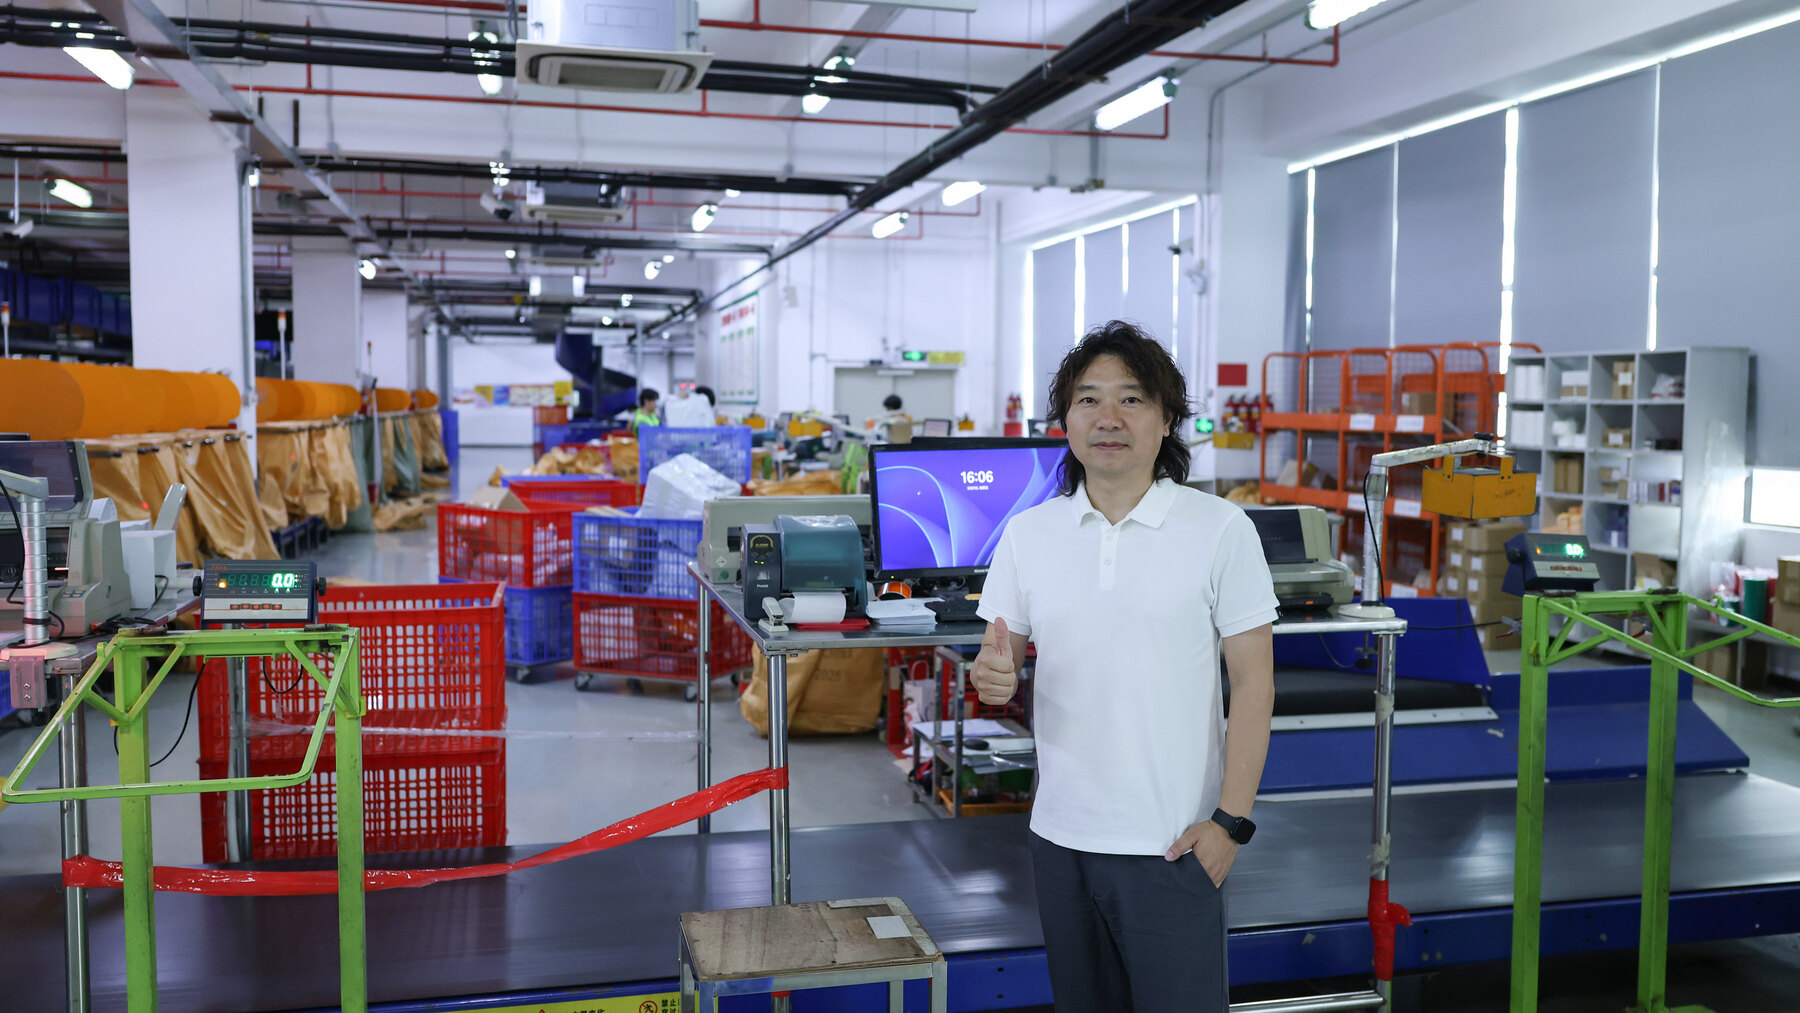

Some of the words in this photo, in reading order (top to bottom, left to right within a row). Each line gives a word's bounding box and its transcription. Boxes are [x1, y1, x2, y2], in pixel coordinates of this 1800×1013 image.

[960, 471, 994, 484] 16:06
[271, 573, 295, 588] 0.0
[814, 669, 842, 682] 2025
[661, 998, 680, 1008] 禁止
